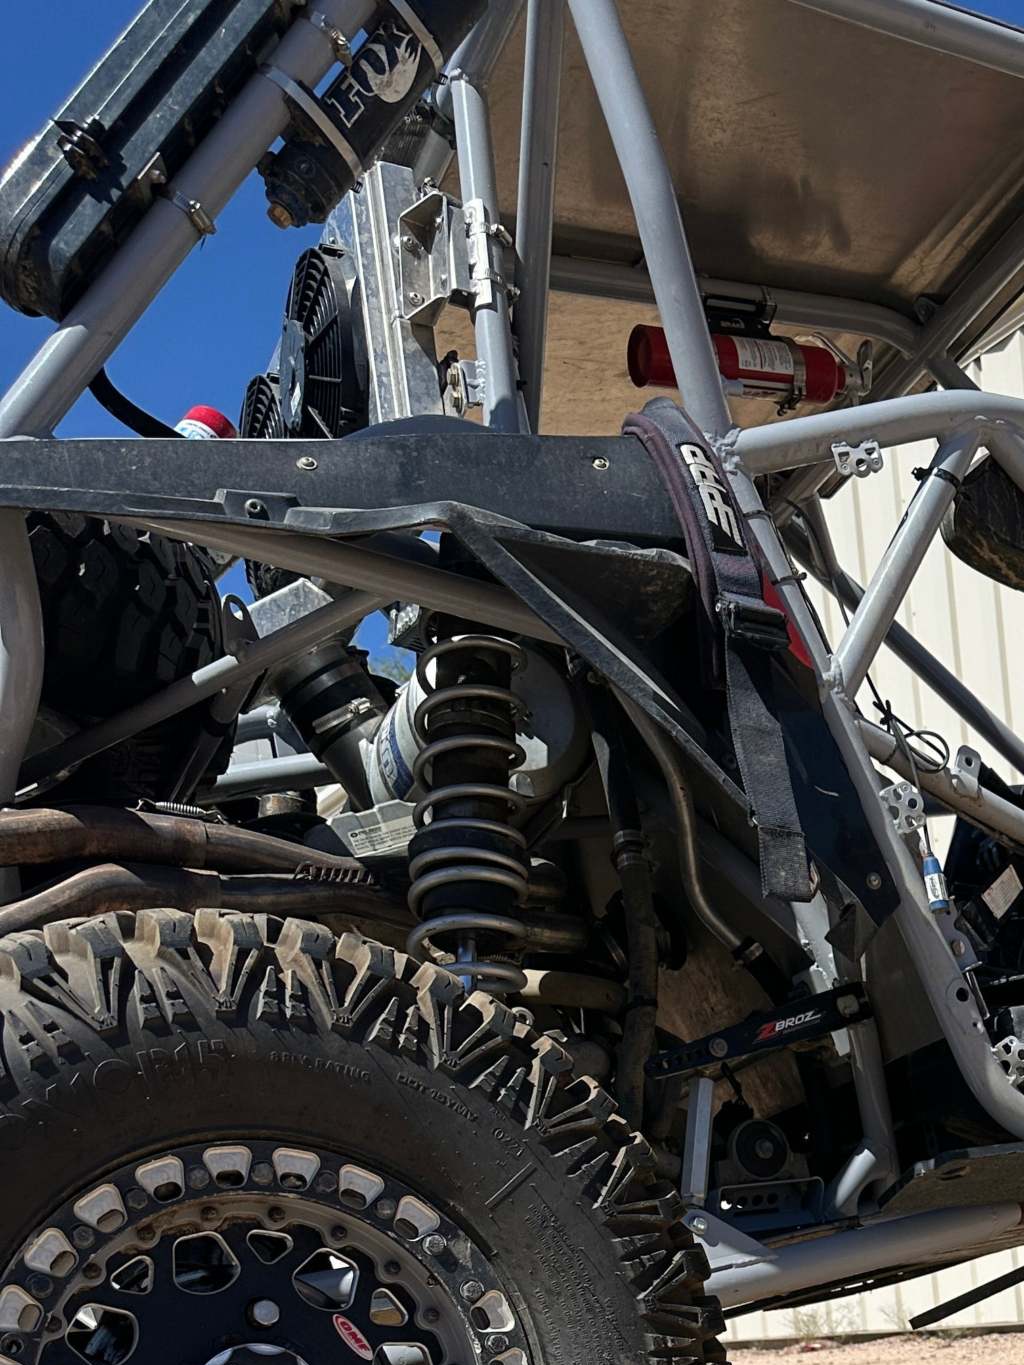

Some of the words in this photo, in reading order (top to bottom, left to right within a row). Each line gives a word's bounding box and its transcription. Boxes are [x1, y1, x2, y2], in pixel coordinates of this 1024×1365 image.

[324, 23, 422, 129] FOX
[680, 444, 743, 548] PRP
[339, 1319, 369, 1353] OMF
